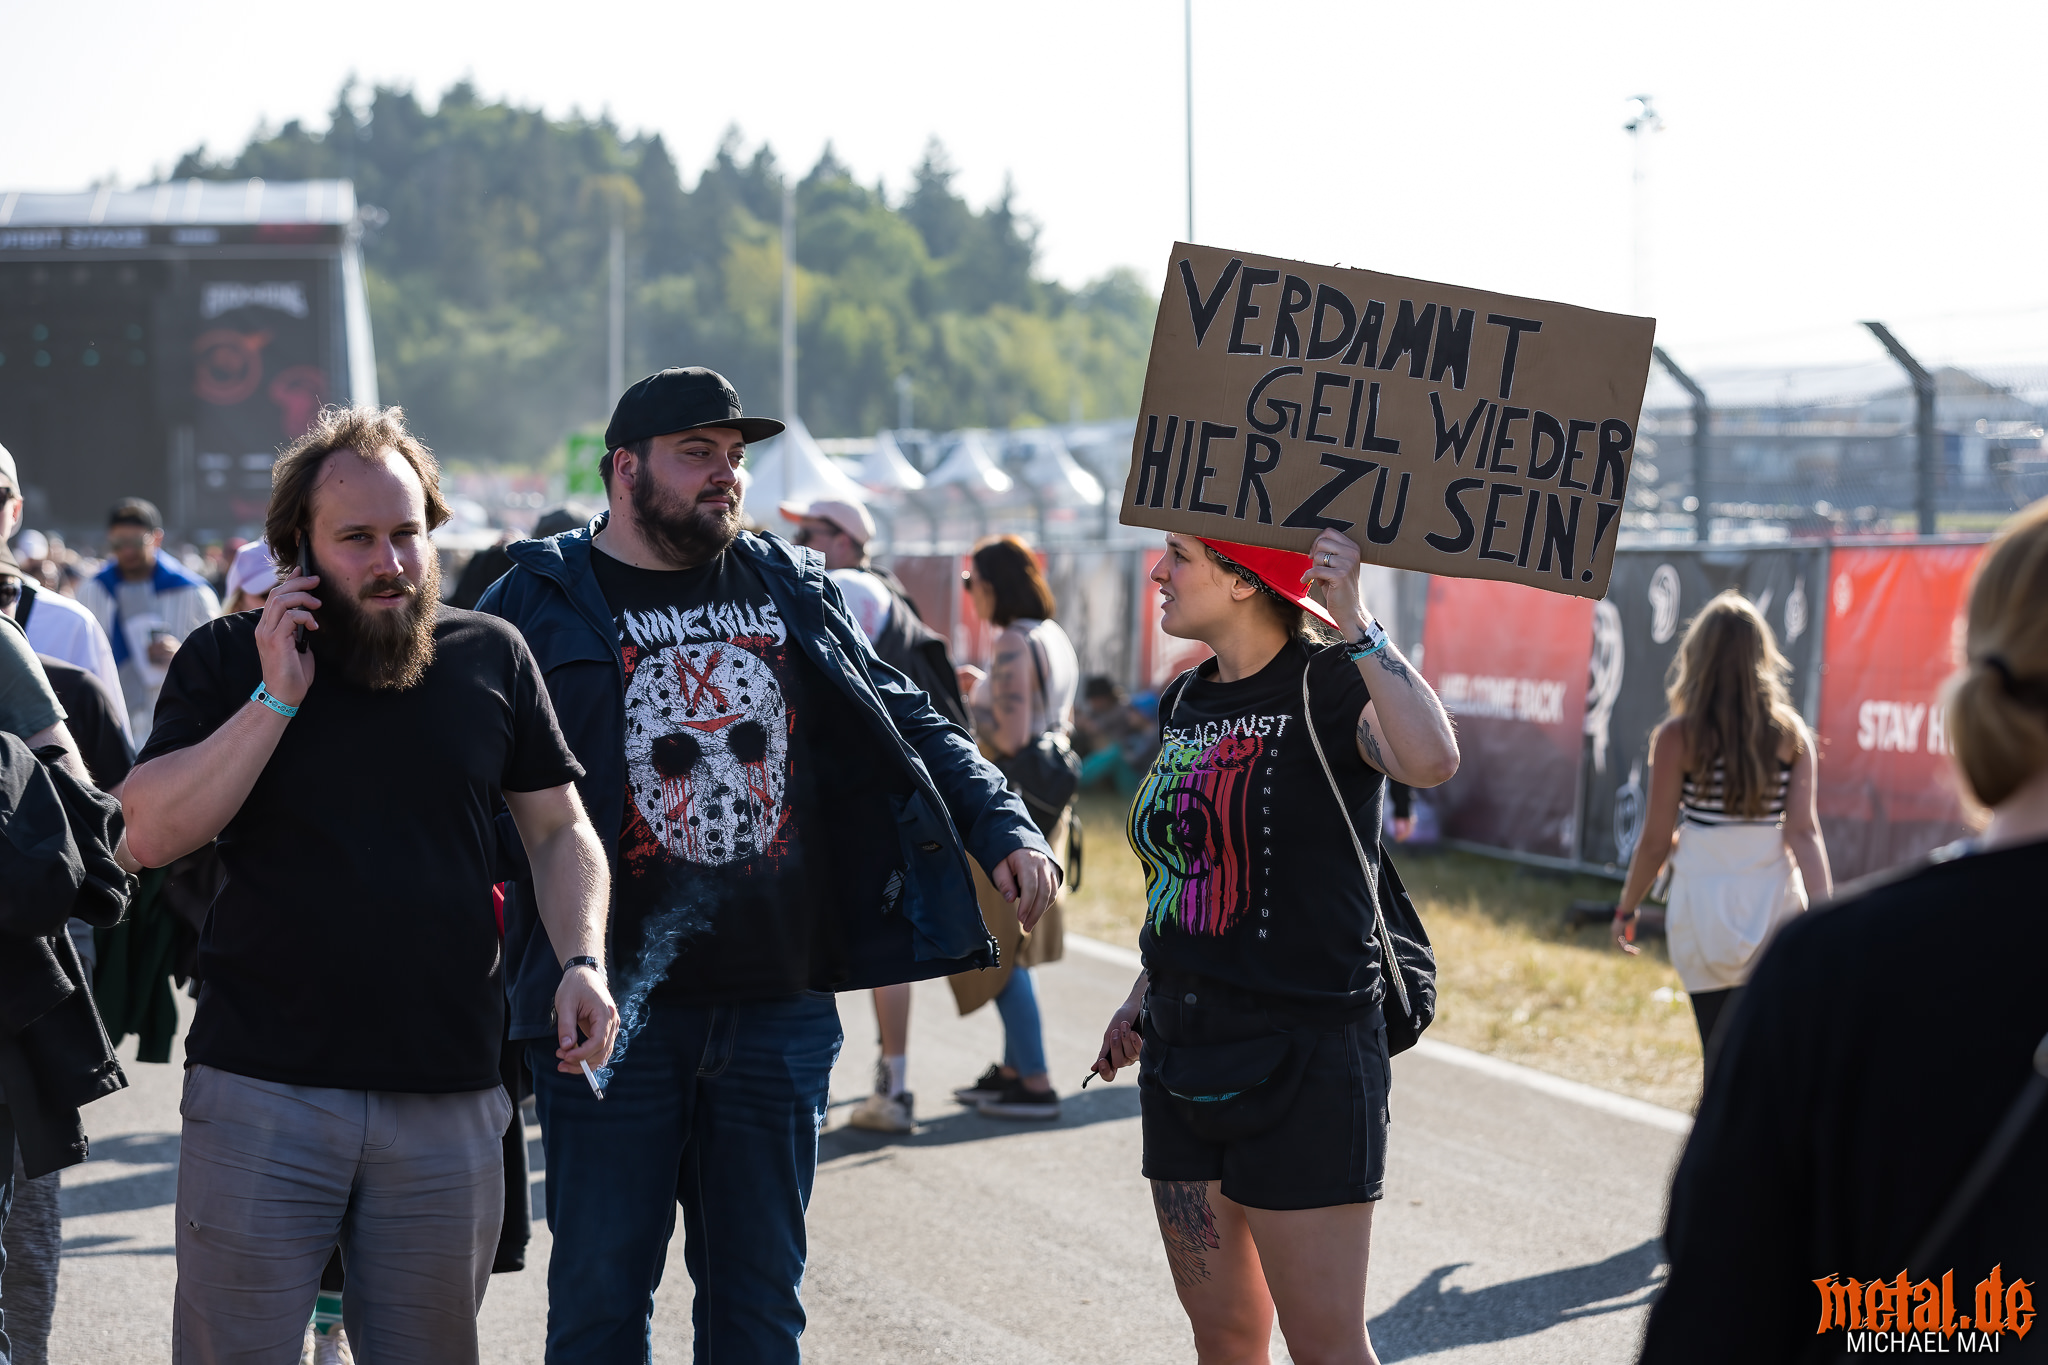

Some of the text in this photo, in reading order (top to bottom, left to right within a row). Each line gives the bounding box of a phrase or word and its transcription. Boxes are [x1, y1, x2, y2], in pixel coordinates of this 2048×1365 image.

[1177, 257, 1543, 400] VERDAMMT
[1134, 414, 1619, 584] HIER ZU SEIN!
[1245, 365, 1633, 499] GEIL WIEDER
[623, 604, 712, 651] NINE
[706, 592, 788, 647] KILLS
[1857, 699, 1927, 754] STAY
